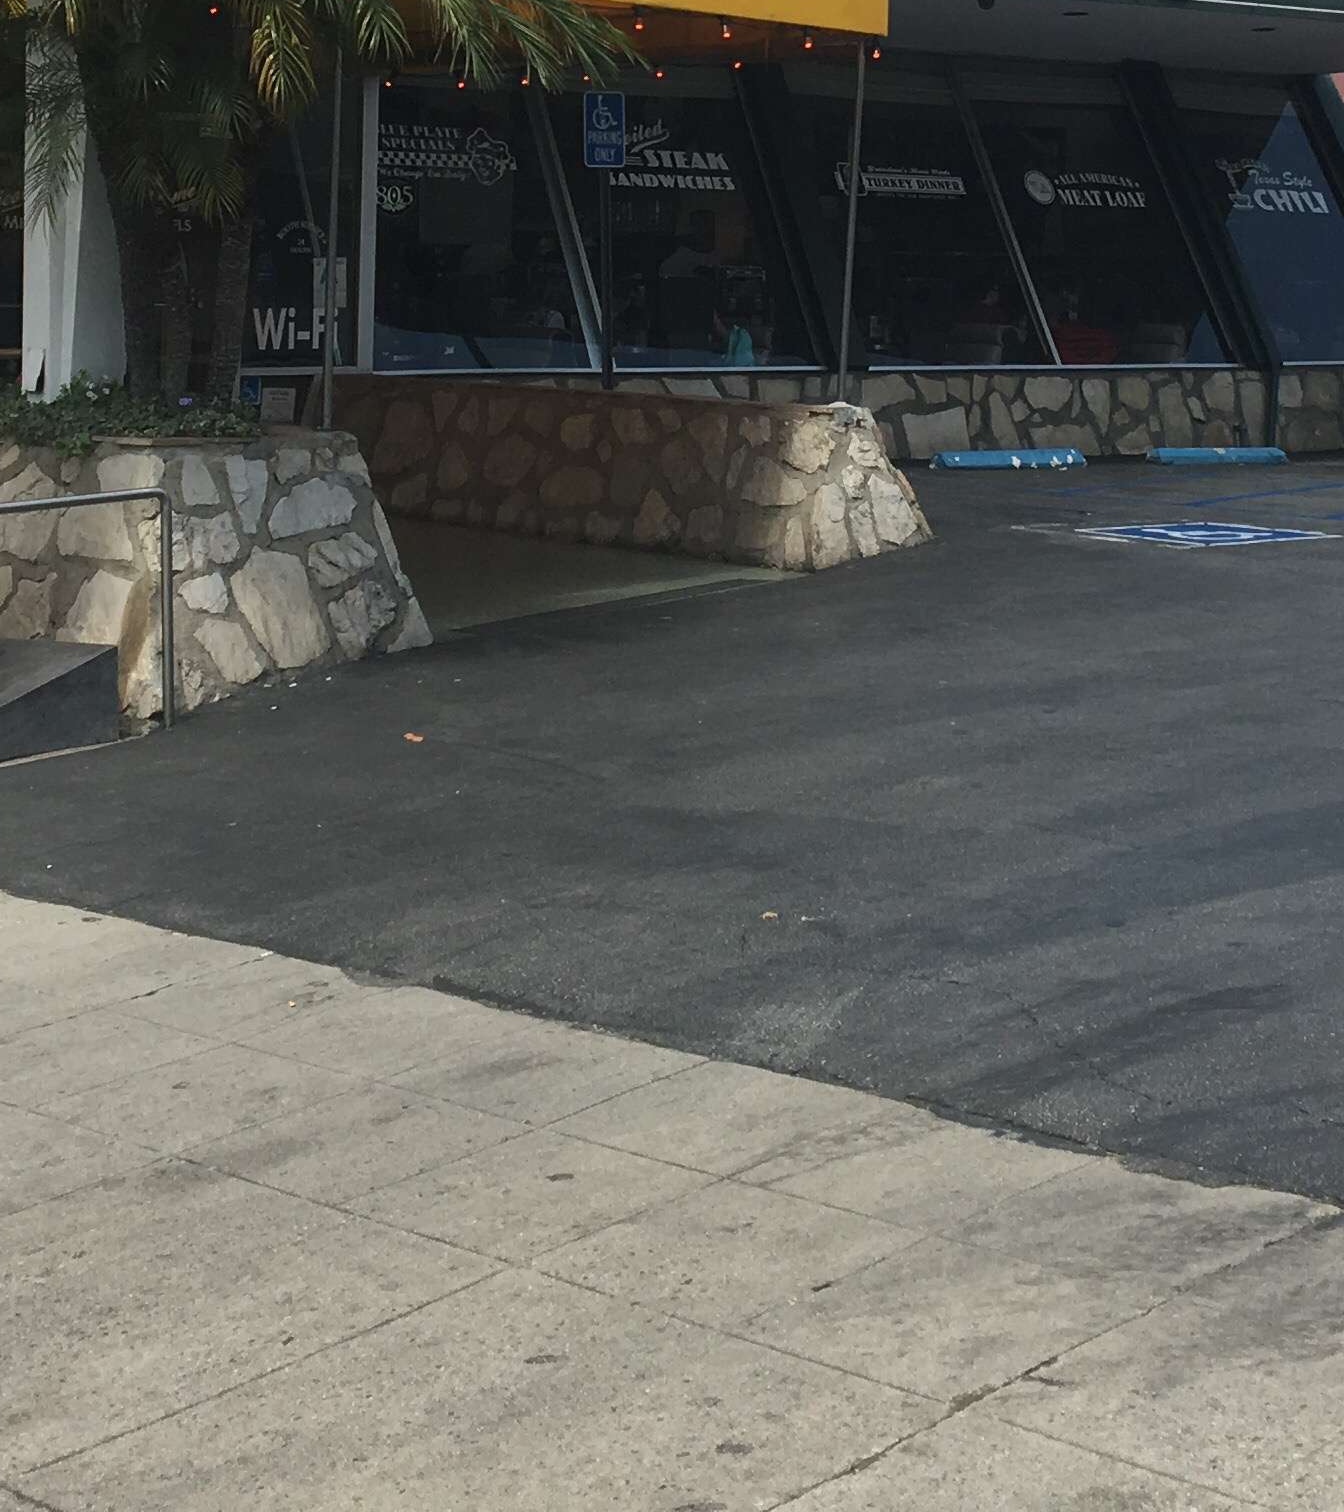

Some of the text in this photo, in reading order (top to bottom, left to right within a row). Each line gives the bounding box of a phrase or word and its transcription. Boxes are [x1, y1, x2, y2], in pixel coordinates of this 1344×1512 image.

[412, 125, 462, 139] PLATE
[587, 130, 622, 145] PARKING
[381, 137, 456, 150] SPECIALS
[593, 147, 616, 162] ONLY
[642, 149, 730, 170] STEAK
[865, 176, 961, 191] TURKEY DINNER
[1059, 172, 1135, 188] ALL AMERICAN
[377, 185, 414, 205] 805
[1056, 188, 1146, 207] MEAT LOAF
[1253, 188, 1329, 214] CHILI
